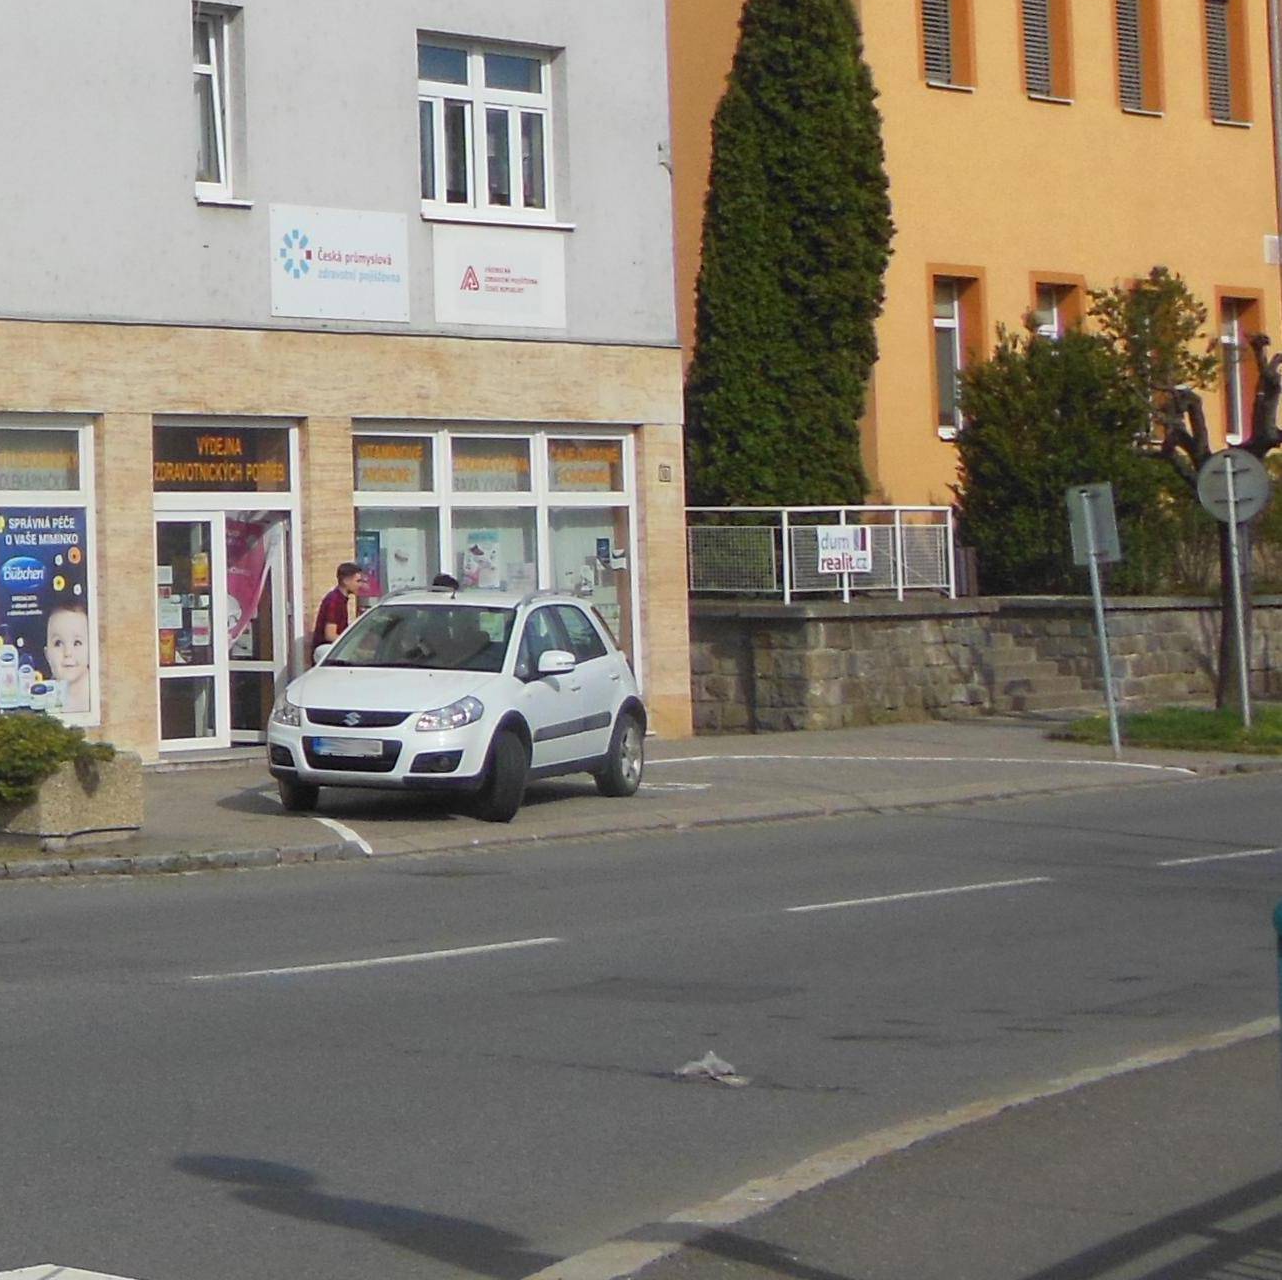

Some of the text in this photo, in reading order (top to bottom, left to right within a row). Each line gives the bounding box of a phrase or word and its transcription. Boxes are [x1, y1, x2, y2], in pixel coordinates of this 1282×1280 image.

[318, 247, 342, 263] Česká
[197, 435, 242, 456] VÝDEJNA
[8, 515, 75, 529] SPRÁVNÁ PÉČE
[5, 531, 79, 545] O VAŠE MIMINKO
[3, 565, 44, 581] Bübchen
